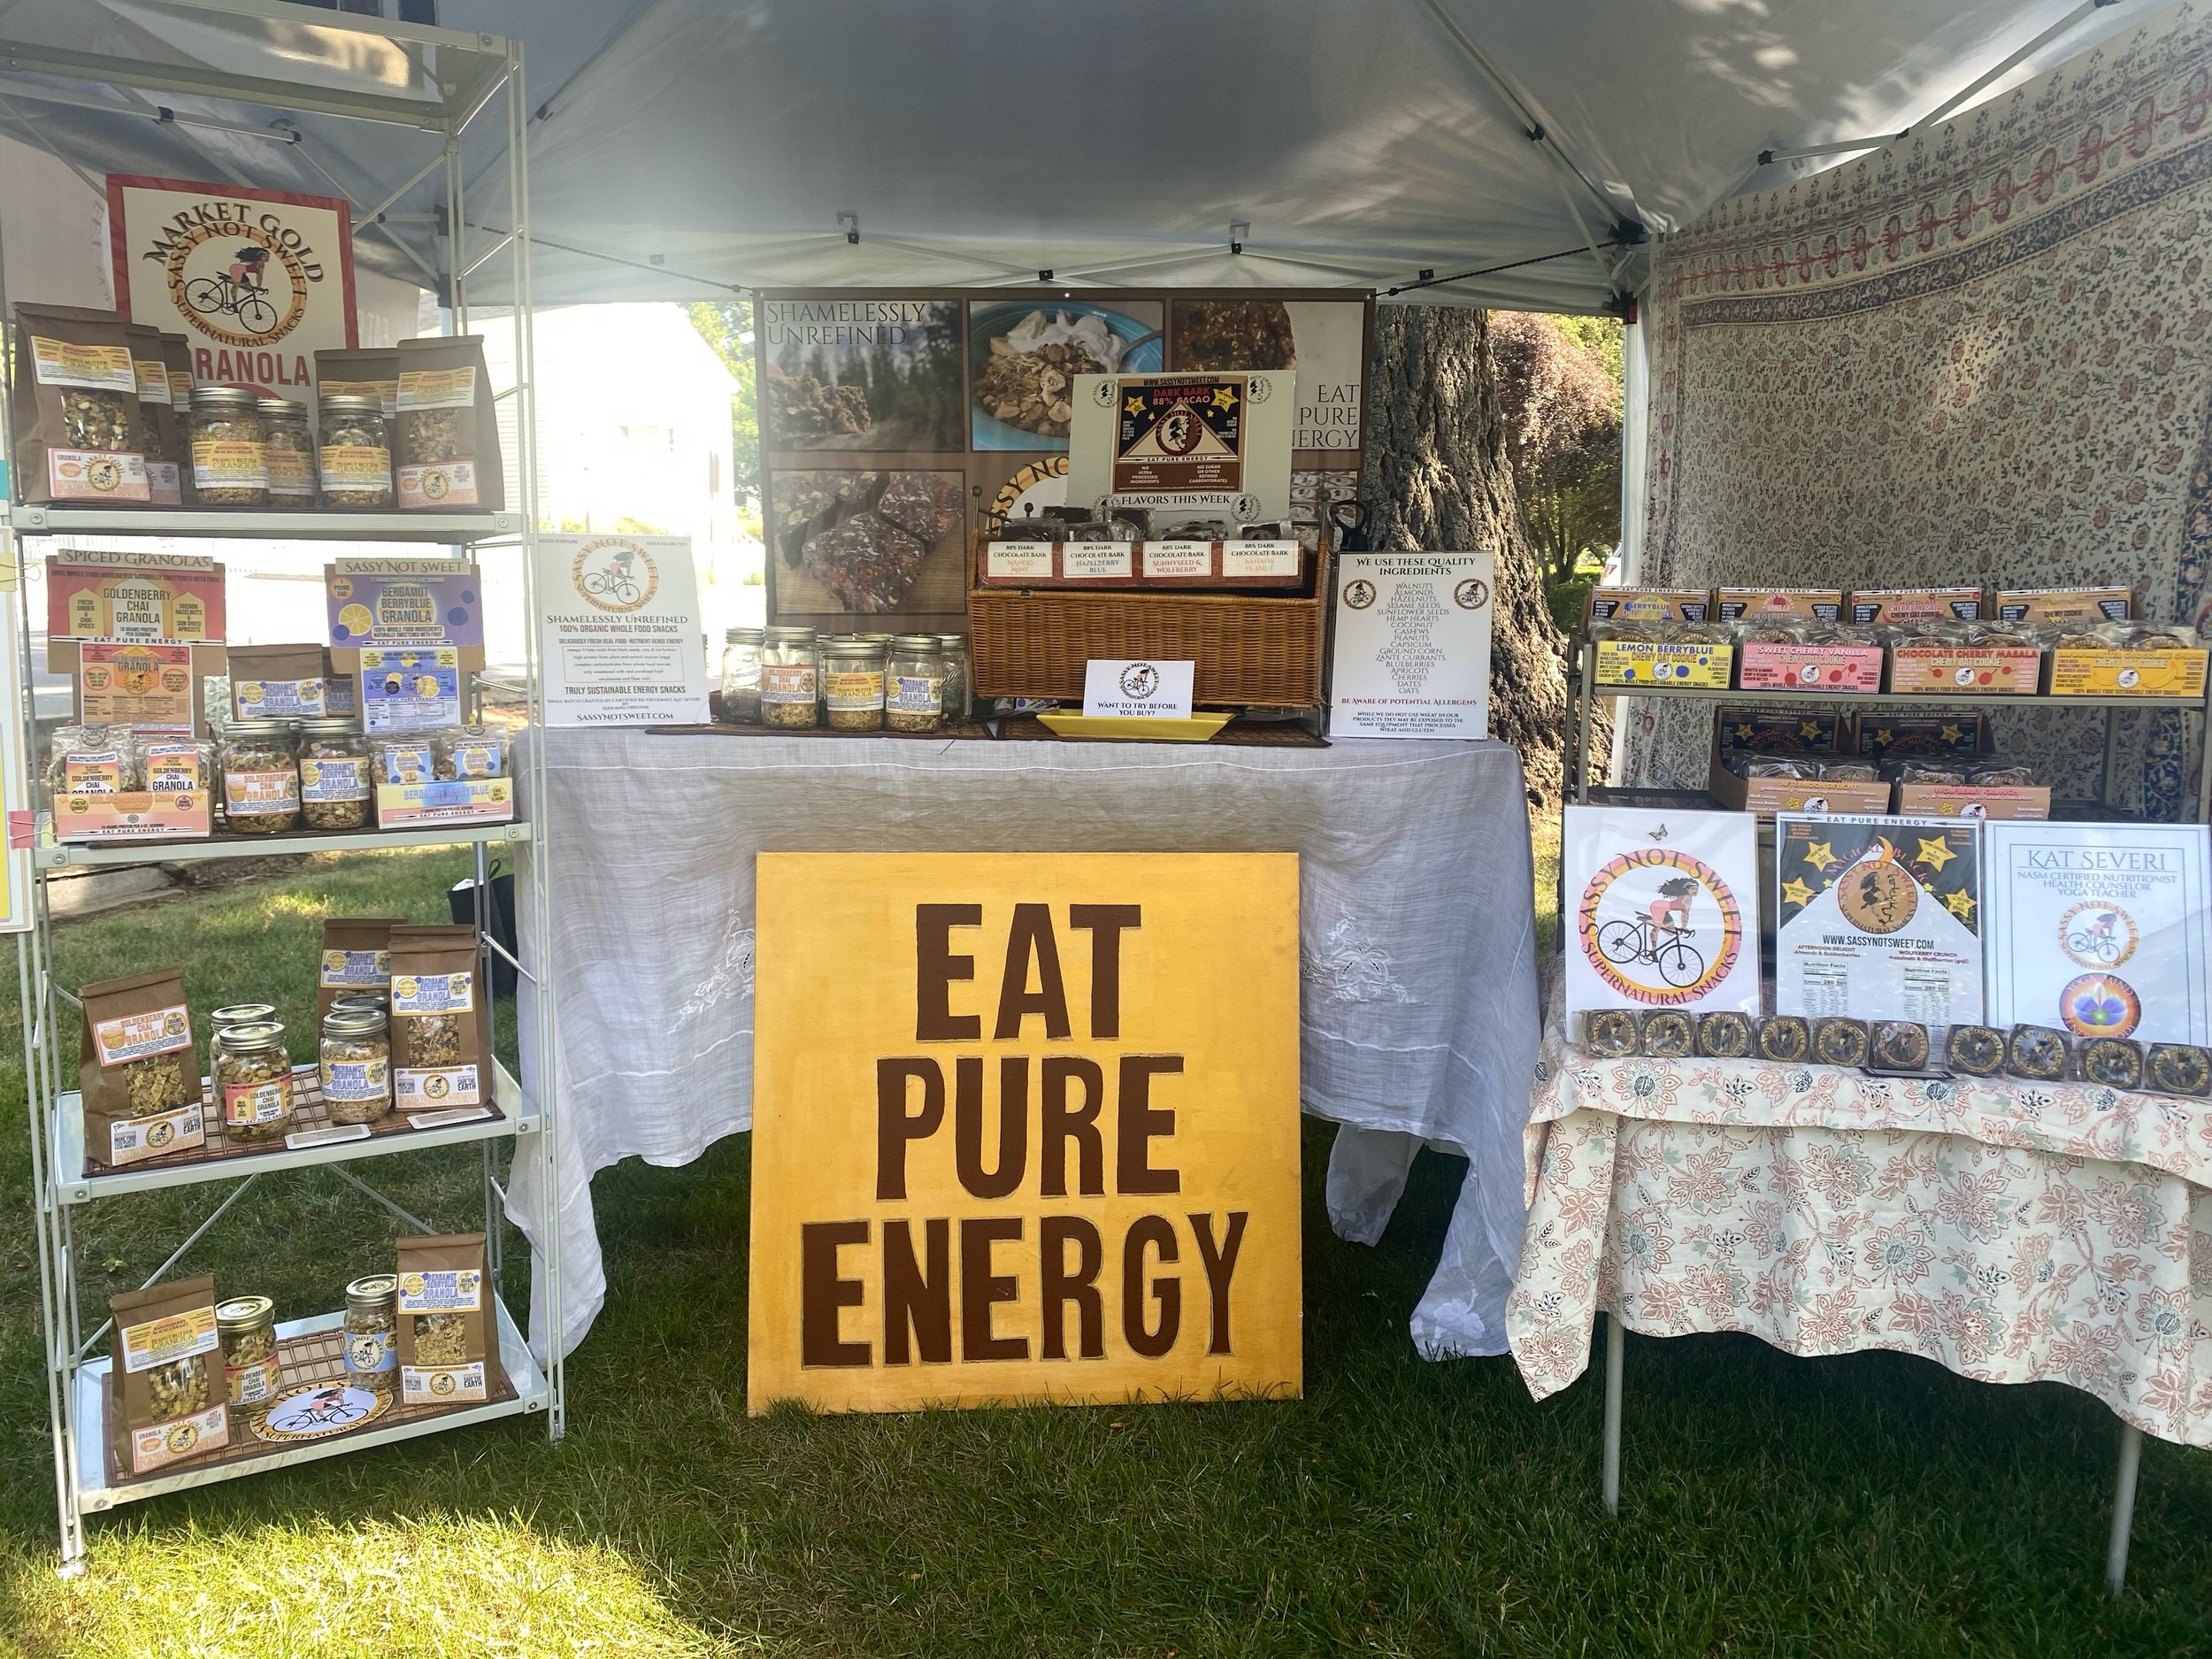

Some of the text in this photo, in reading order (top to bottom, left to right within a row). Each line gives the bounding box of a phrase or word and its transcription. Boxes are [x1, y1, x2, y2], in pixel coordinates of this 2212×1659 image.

[142, 203, 251, 265] MARKET
[259, 214, 324, 283] GOLD
[167, 229, 200, 291] SASSY
[204, 222, 257, 239] NOT
[261, 234, 307, 300] SWEET
[766, 303, 926, 324] SHAMELESSLY
[171, 295, 304, 347] SUPERNATURAL SNACKS
[768, 323, 906, 345] UNREFINED
[196, 348, 311, 386] RANOLA
[1143, 377, 1219, 386] WWW.SASSYNOTSWEET.COM
[1184, 388, 1210, 396] BARK
[1317, 385, 1359, 402] EAT
[1300, 407, 1357, 425] PURE
[1122, 496, 1169, 505] FLAVORS
[1200, 493, 1230, 504] WEEK
[65, 551, 209, 567] SPICED GRANOLAS
[1357, 557, 1371, 567] WE
[1428, 557, 1476, 568] QUALITY
[346, 560, 463, 573] SASSY NOT SWEET
[104, 588, 171, 600] GOLDENBERRY
[382, 588, 428, 597] BERGAMOT
[127, 602, 149, 611] CHAI
[381, 598, 431, 609] BERRYBLUE
[117, 612, 160, 624] GRANOLA
[382, 611, 432, 623] GRANOLA
[547, 614, 687, 624] SHAMELESSLY UNREFINED
[1657, 645, 1714, 654] BERRYBLUE
[1897, 649, 2038, 658] CHOCOLATE CHERRY MASALA
[1672, 654, 1697, 663] COOKIE
[2028, 849, 2166, 870] KAT SEVERI
[2051, 872, 2100, 881] CERTIFIED
[2103, 874, 2177, 883] NUTRITIONIST
[2086, 881, 2151, 891] COUNSELOR
[1579, 849, 1742, 941] SASSY NOT SWEET
[2058, 888, 2088, 897] YOGA
[1823, 935, 1934, 949] WWW.SASSYNOTSWEET.COM
[916, 903, 1141, 1041] EAT
[1581, 941, 1691, 1005] SUPERNATURAL
[1692, 951, 1738, 1000] SNACKS
[257, 1101, 280, 1110] GRANOLA
[183, 1124, 200, 1135] EARTH
[876, 1054, 1185, 1201] PURE
[801, 1210, 1249, 1370] ENERGY
[151, 1334, 195, 1350] GRANOLA
[243, 1381, 265, 1391] GRANOLA
[464, 1379, 482, 1388] EARTH
